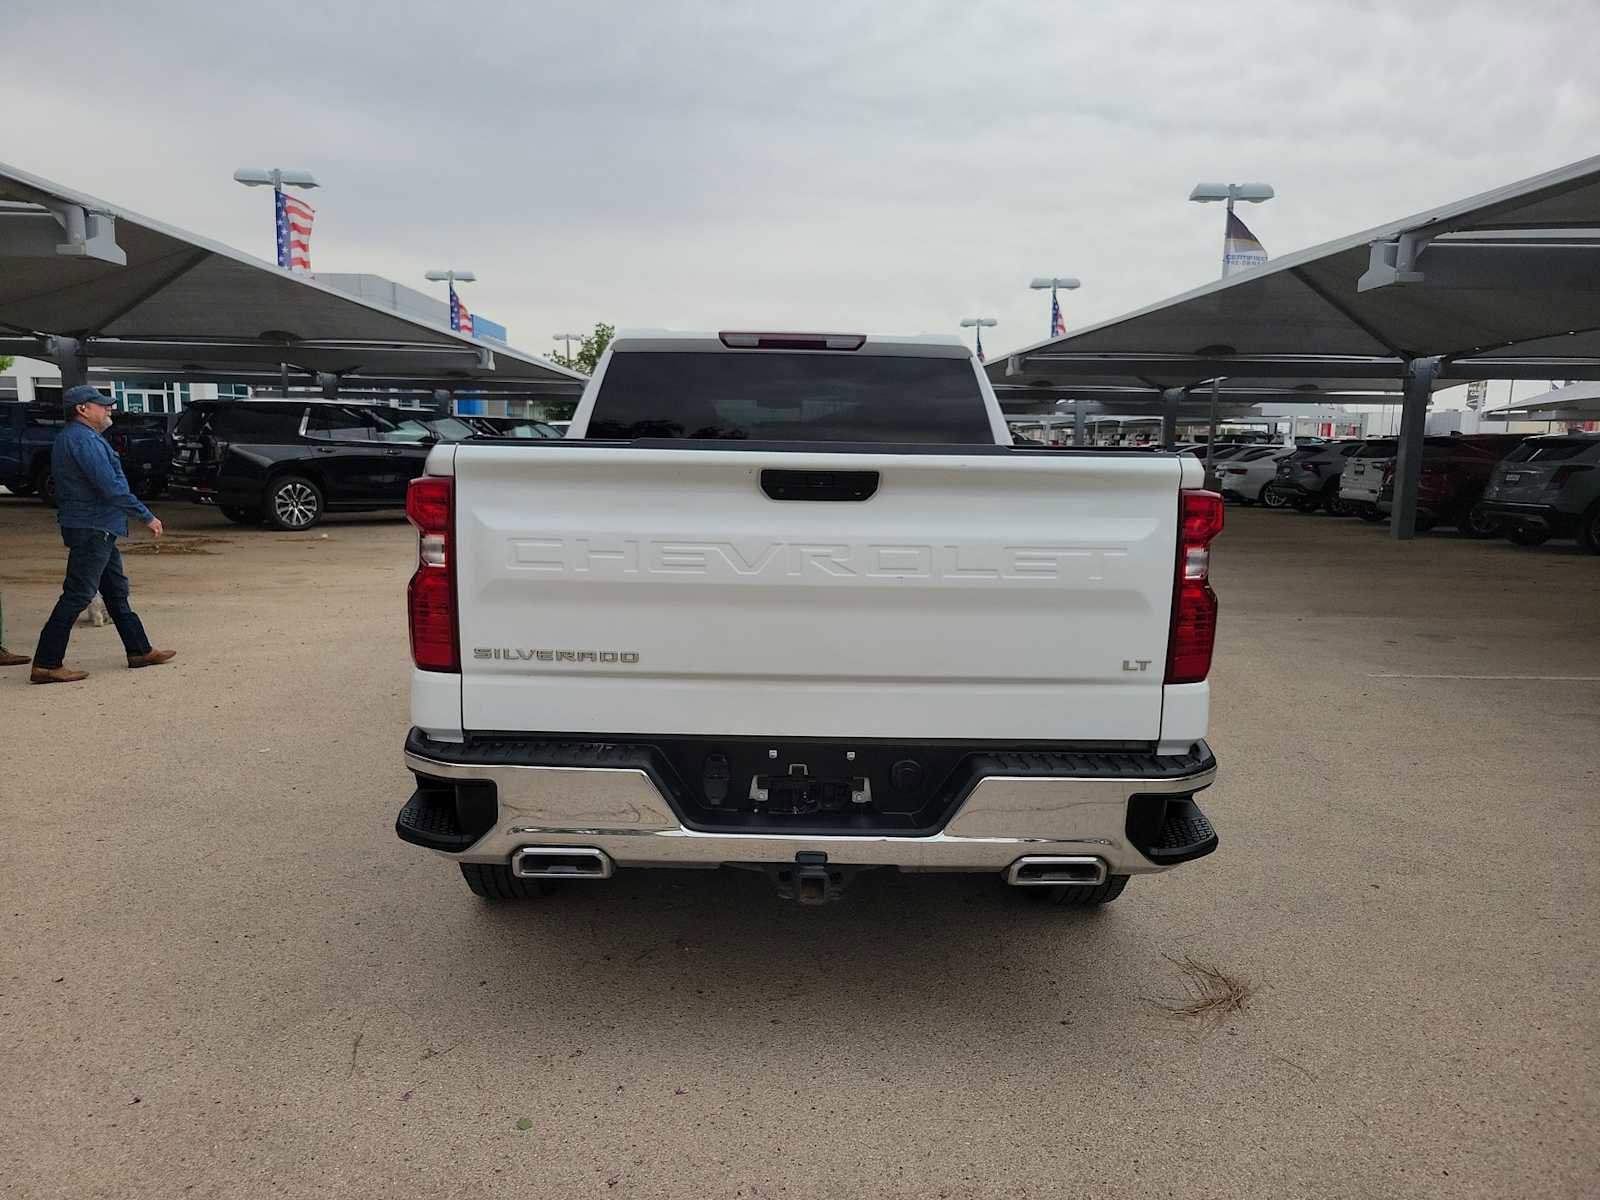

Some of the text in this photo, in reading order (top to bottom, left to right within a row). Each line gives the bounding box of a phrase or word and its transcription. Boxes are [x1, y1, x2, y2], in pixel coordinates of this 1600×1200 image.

[507, 538, 1128, 580] CHEVROLET
[473, 647, 640, 664] SILVERADO
[1122, 659, 1152, 671] LT
